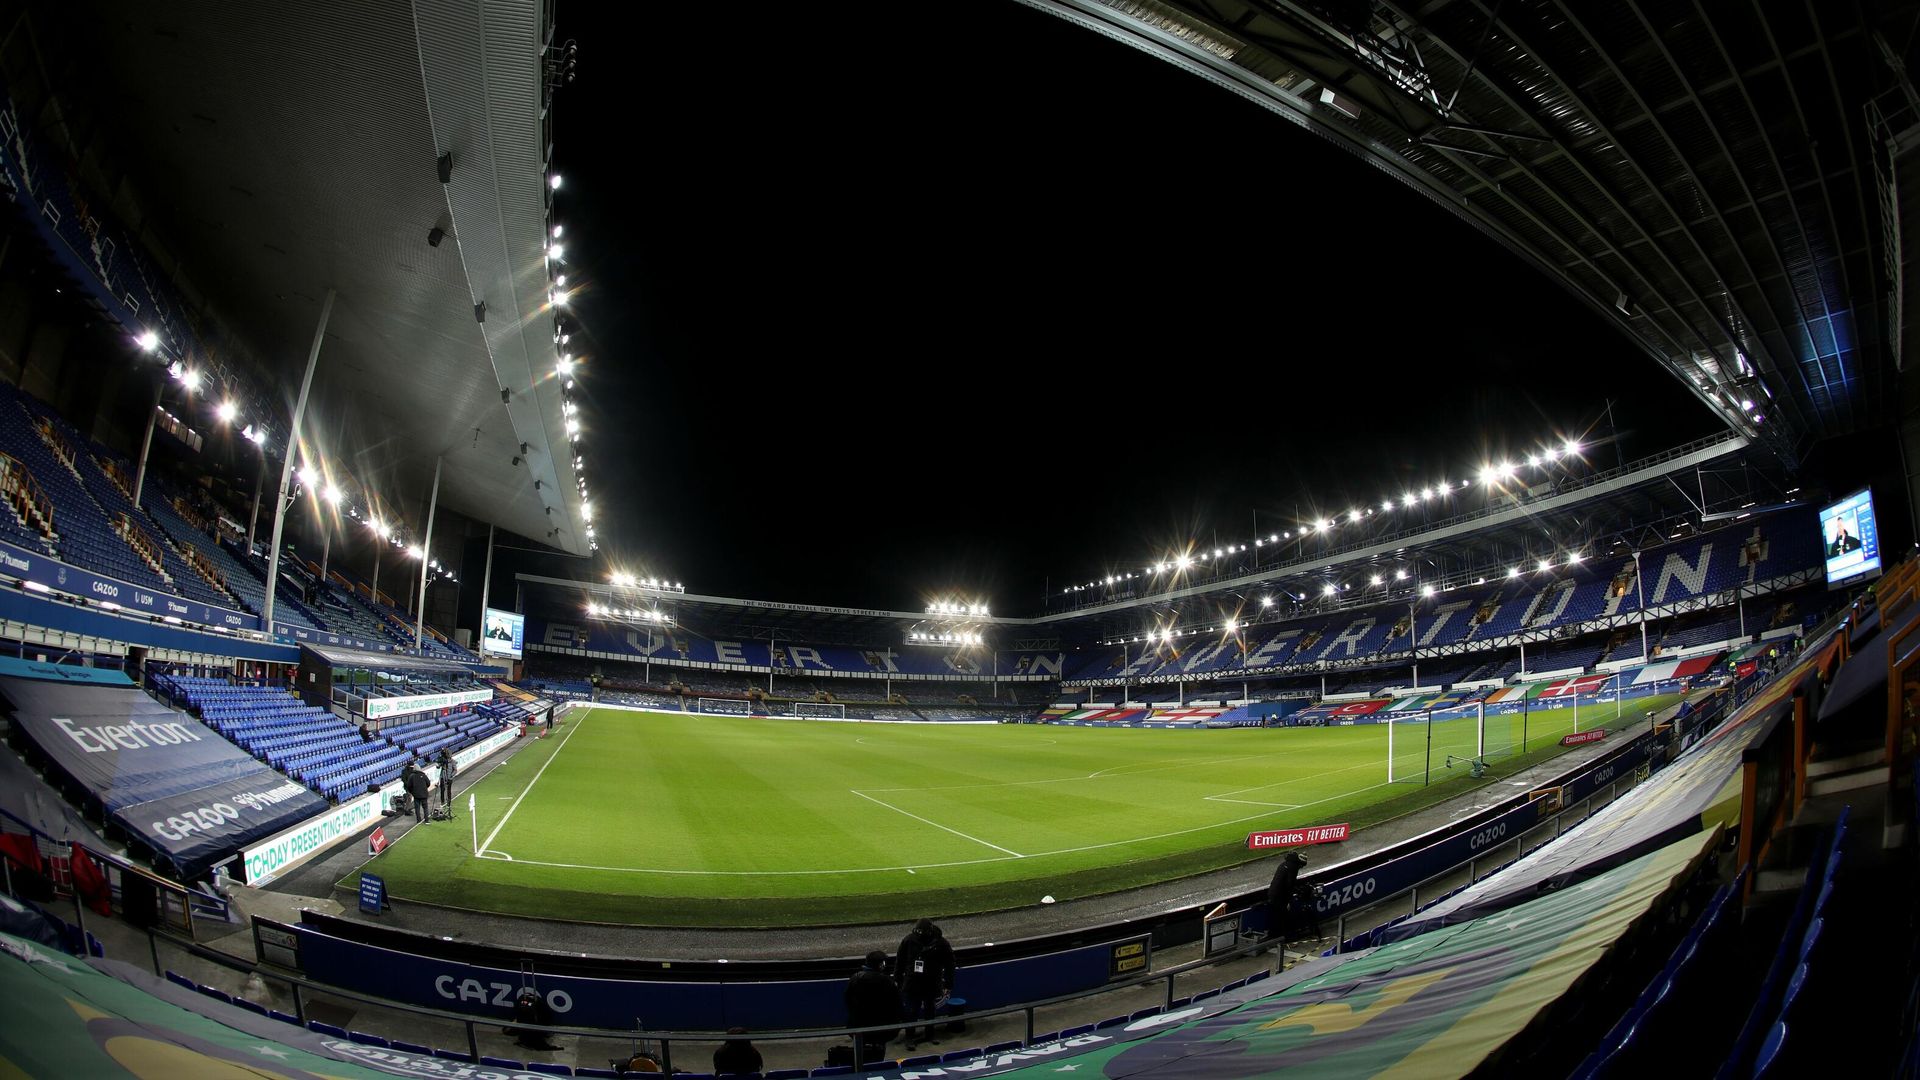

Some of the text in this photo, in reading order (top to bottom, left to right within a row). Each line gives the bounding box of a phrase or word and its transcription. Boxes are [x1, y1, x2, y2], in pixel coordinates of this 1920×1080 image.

[92, 581, 119, 597] CAZOO
[758, 601, 786, 609] HOWARD
[225, 614, 242, 625] CAZOO
[51, 718, 202, 753] Everton
[1594, 766, 1614, 786] CAZOO
[152, 780, 307, 841] CAZOO hummel
[245, 801, 371, 882] TCHDAY PRESENTING PARTNER
[1254, 826, 1345, 847] Emirates FLY BETTER
[1470, 822, 1507, 850] CAZOO
[1315, 877, 1376, 913] CAZOO
